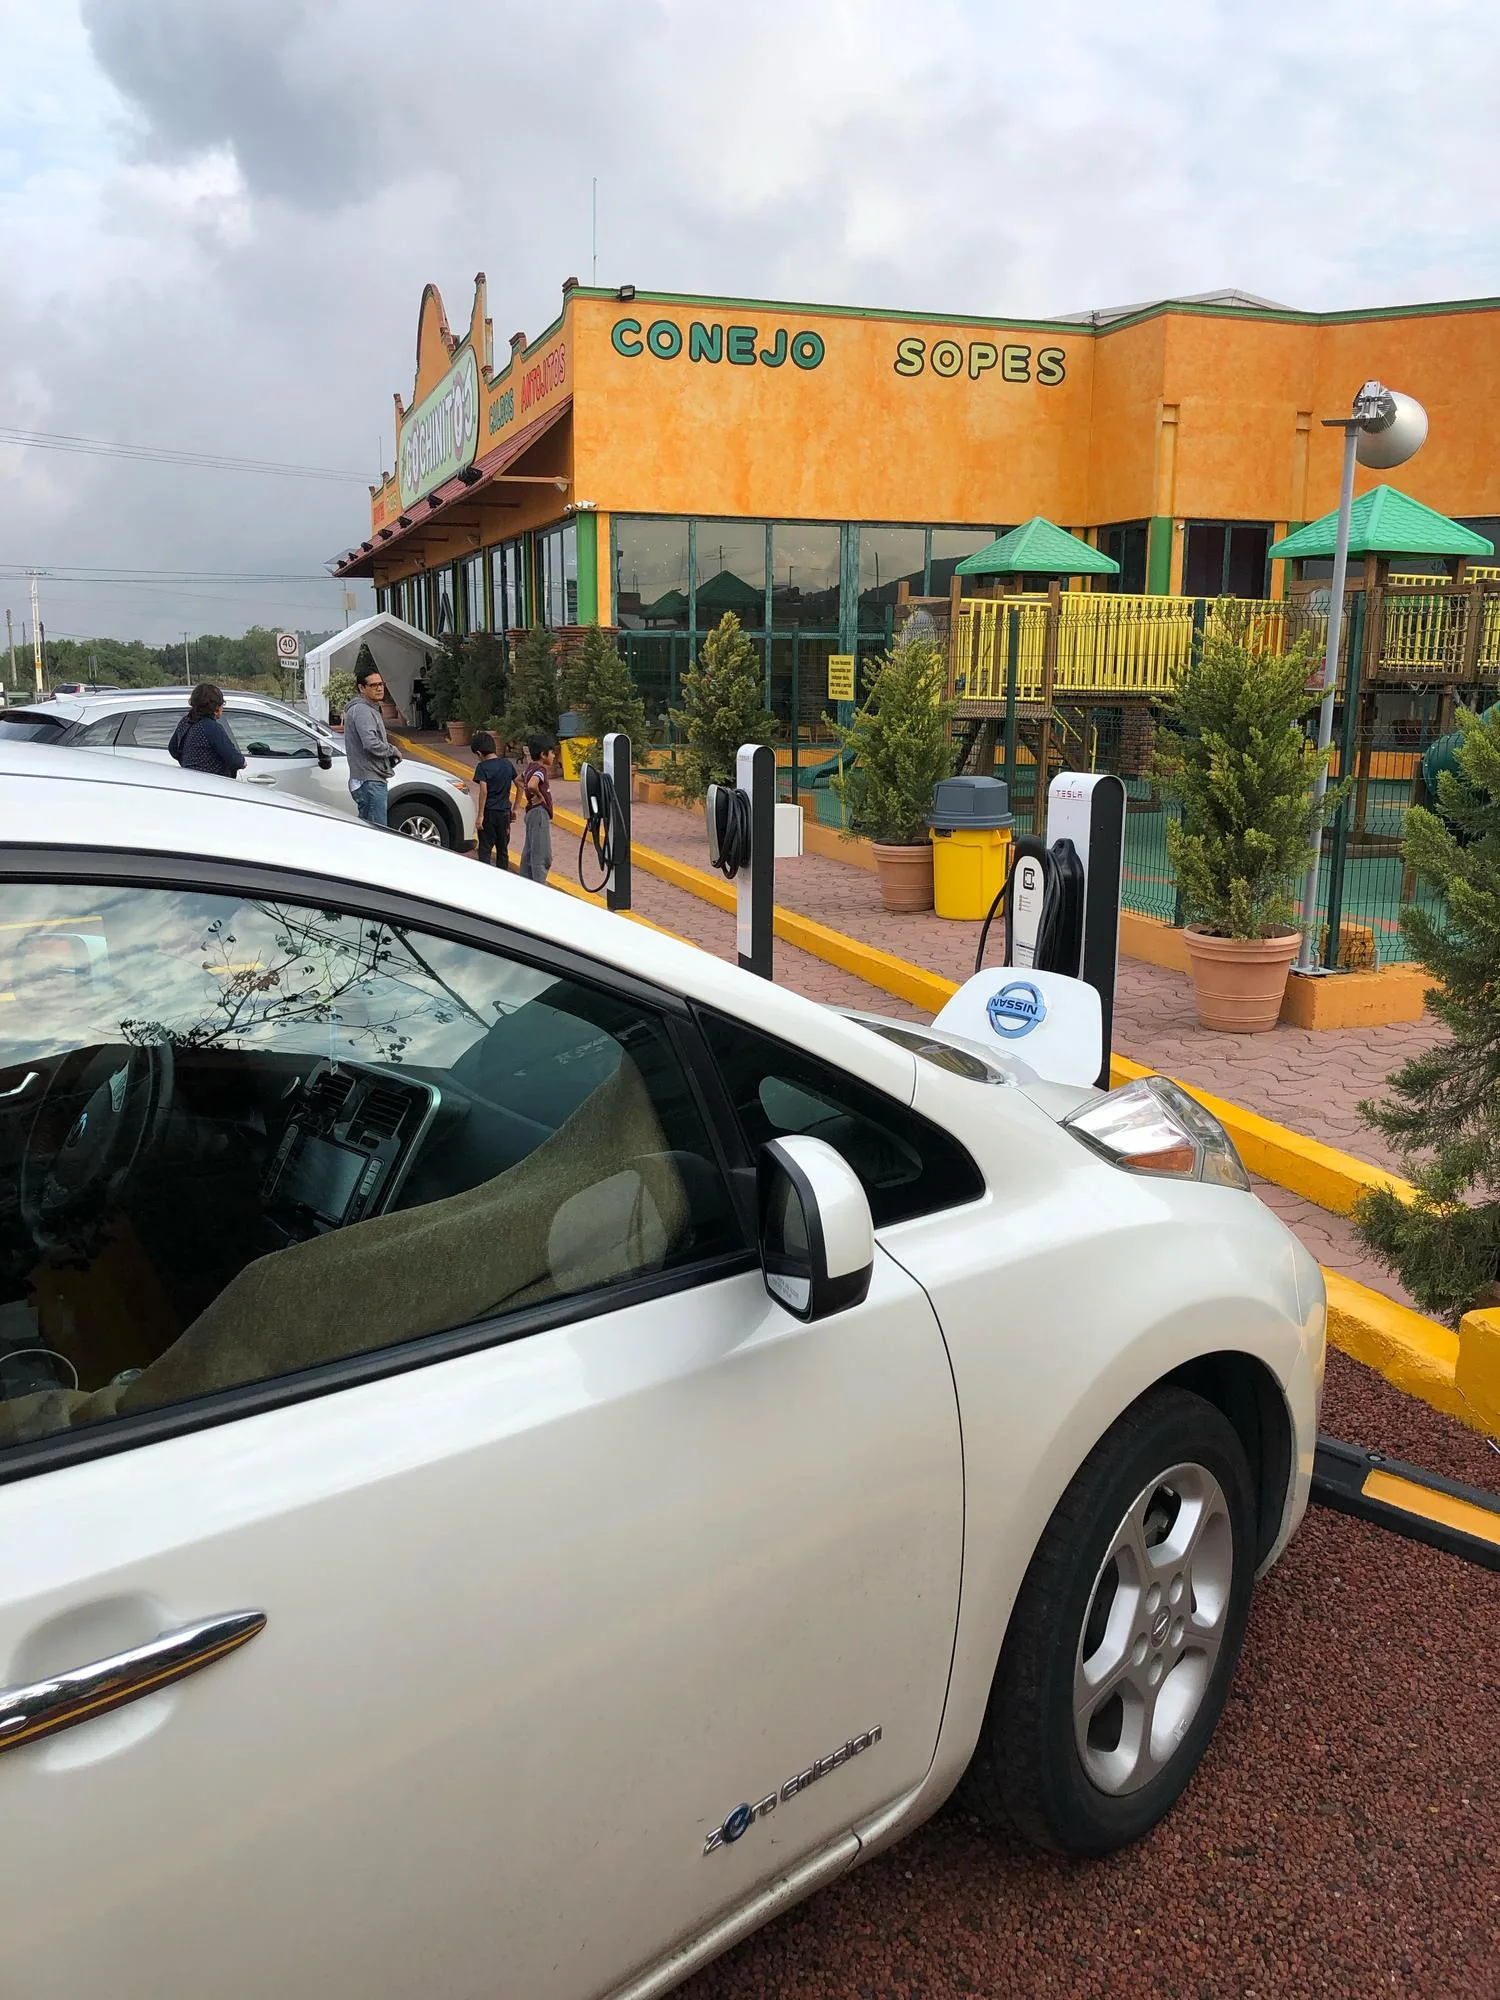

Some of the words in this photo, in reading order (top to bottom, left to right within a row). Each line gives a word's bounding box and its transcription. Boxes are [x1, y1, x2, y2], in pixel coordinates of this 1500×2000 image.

[611, 318, 825, 370] CONEJO
[893, 337, 1066, 386] SOPES
[521, 343, 566, 413] ANTOJITOS
[406, 357, 474, 491] COCHINITOS
[282, 639, 293, 648] 40
[1056, 789, 1083, 799] TESLA
[991, 998, 1038, 1015] NISSAN
[780, 1724, 883, 1802] Emission
